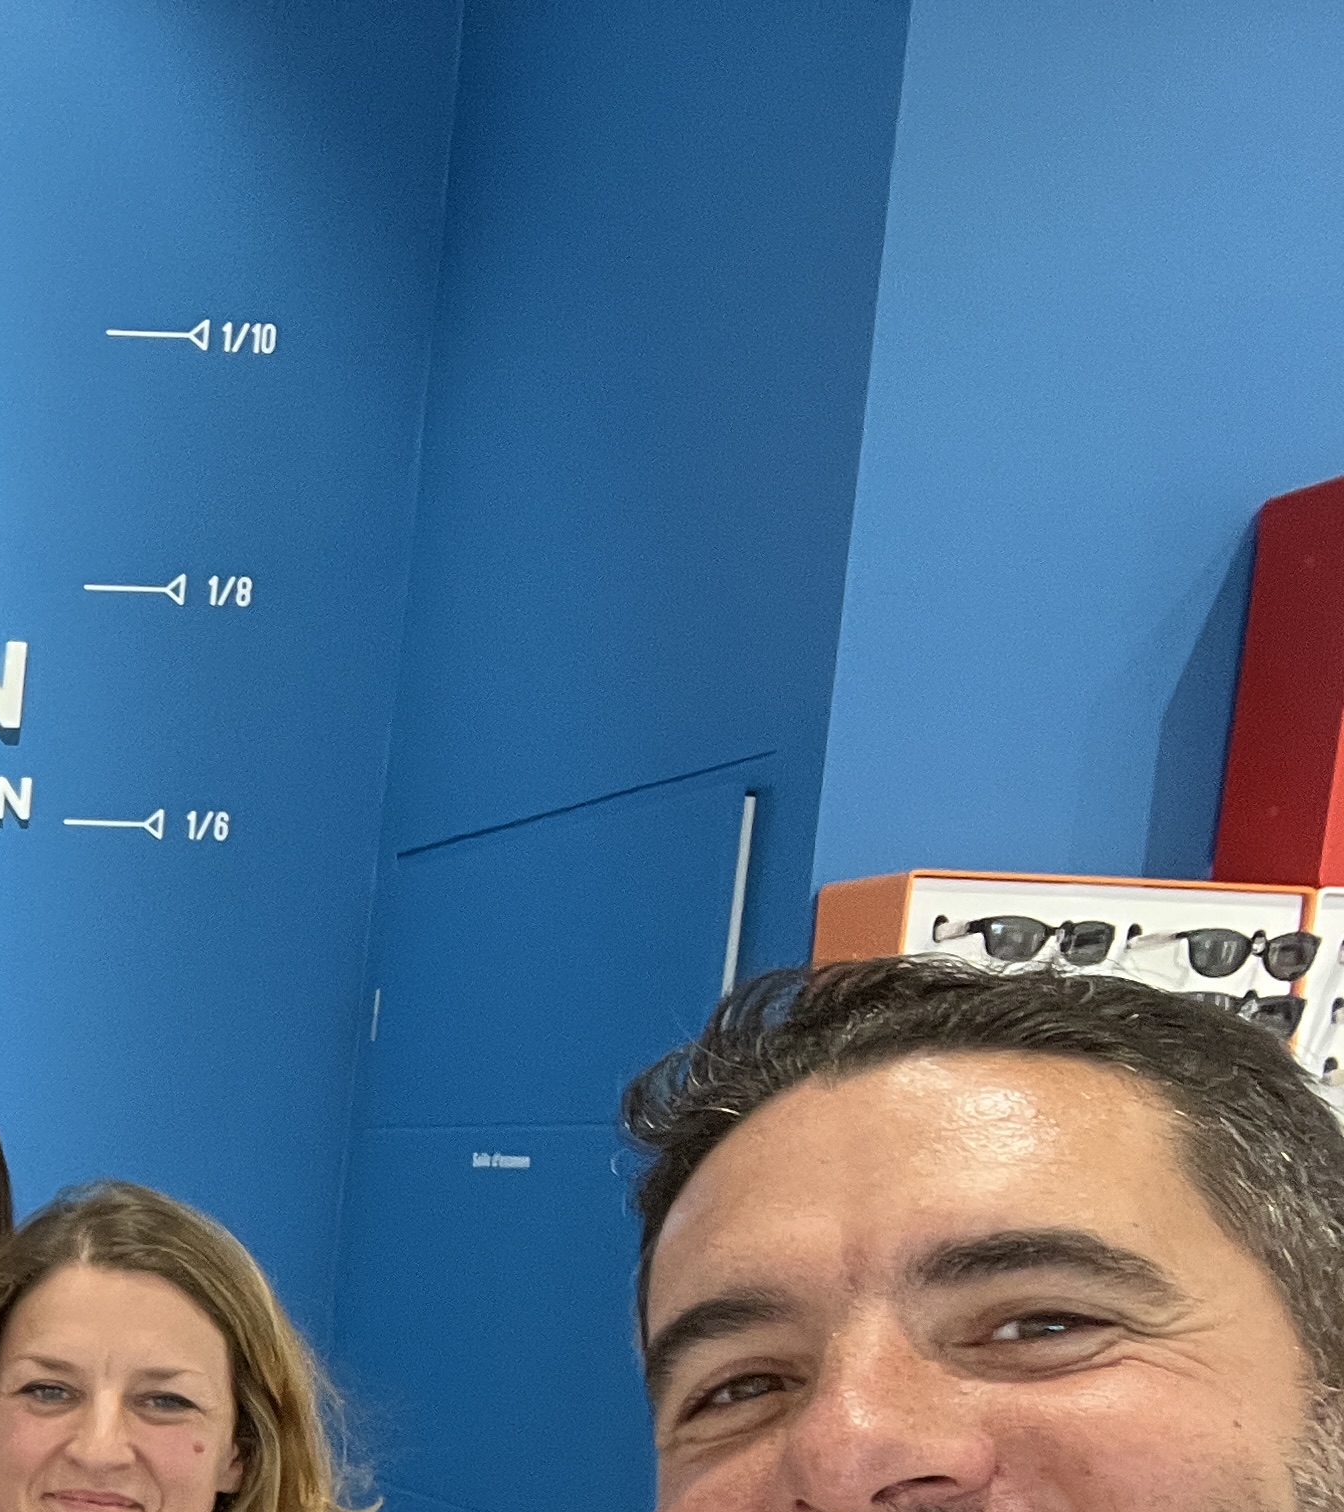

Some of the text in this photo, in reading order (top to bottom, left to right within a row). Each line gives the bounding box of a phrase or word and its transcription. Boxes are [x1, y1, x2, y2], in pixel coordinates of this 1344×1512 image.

[221, 320, 278, 355] 1/10
[207, 575, 254, 608] 1/8
[184, 809, 230, 842] 1/6
